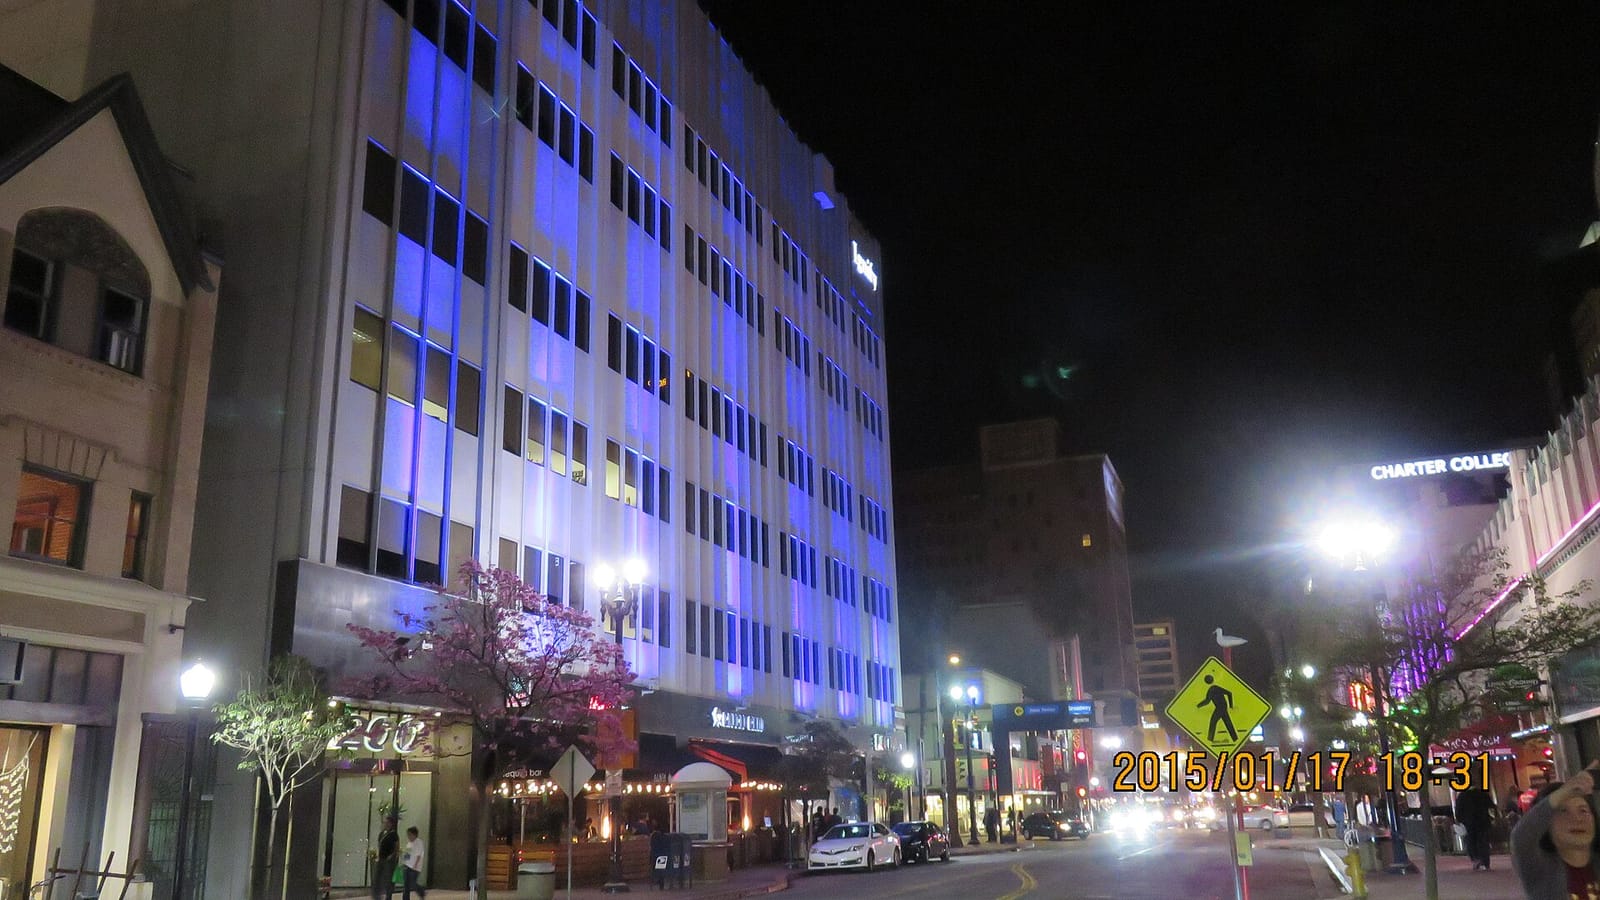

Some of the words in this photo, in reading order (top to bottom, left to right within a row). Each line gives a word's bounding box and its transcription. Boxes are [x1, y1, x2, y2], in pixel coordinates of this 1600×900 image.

[1371, 459, 1447, 480] CHARTER
[327, 713, 424, 753] 200
[529, 768, 543, 777] bar
